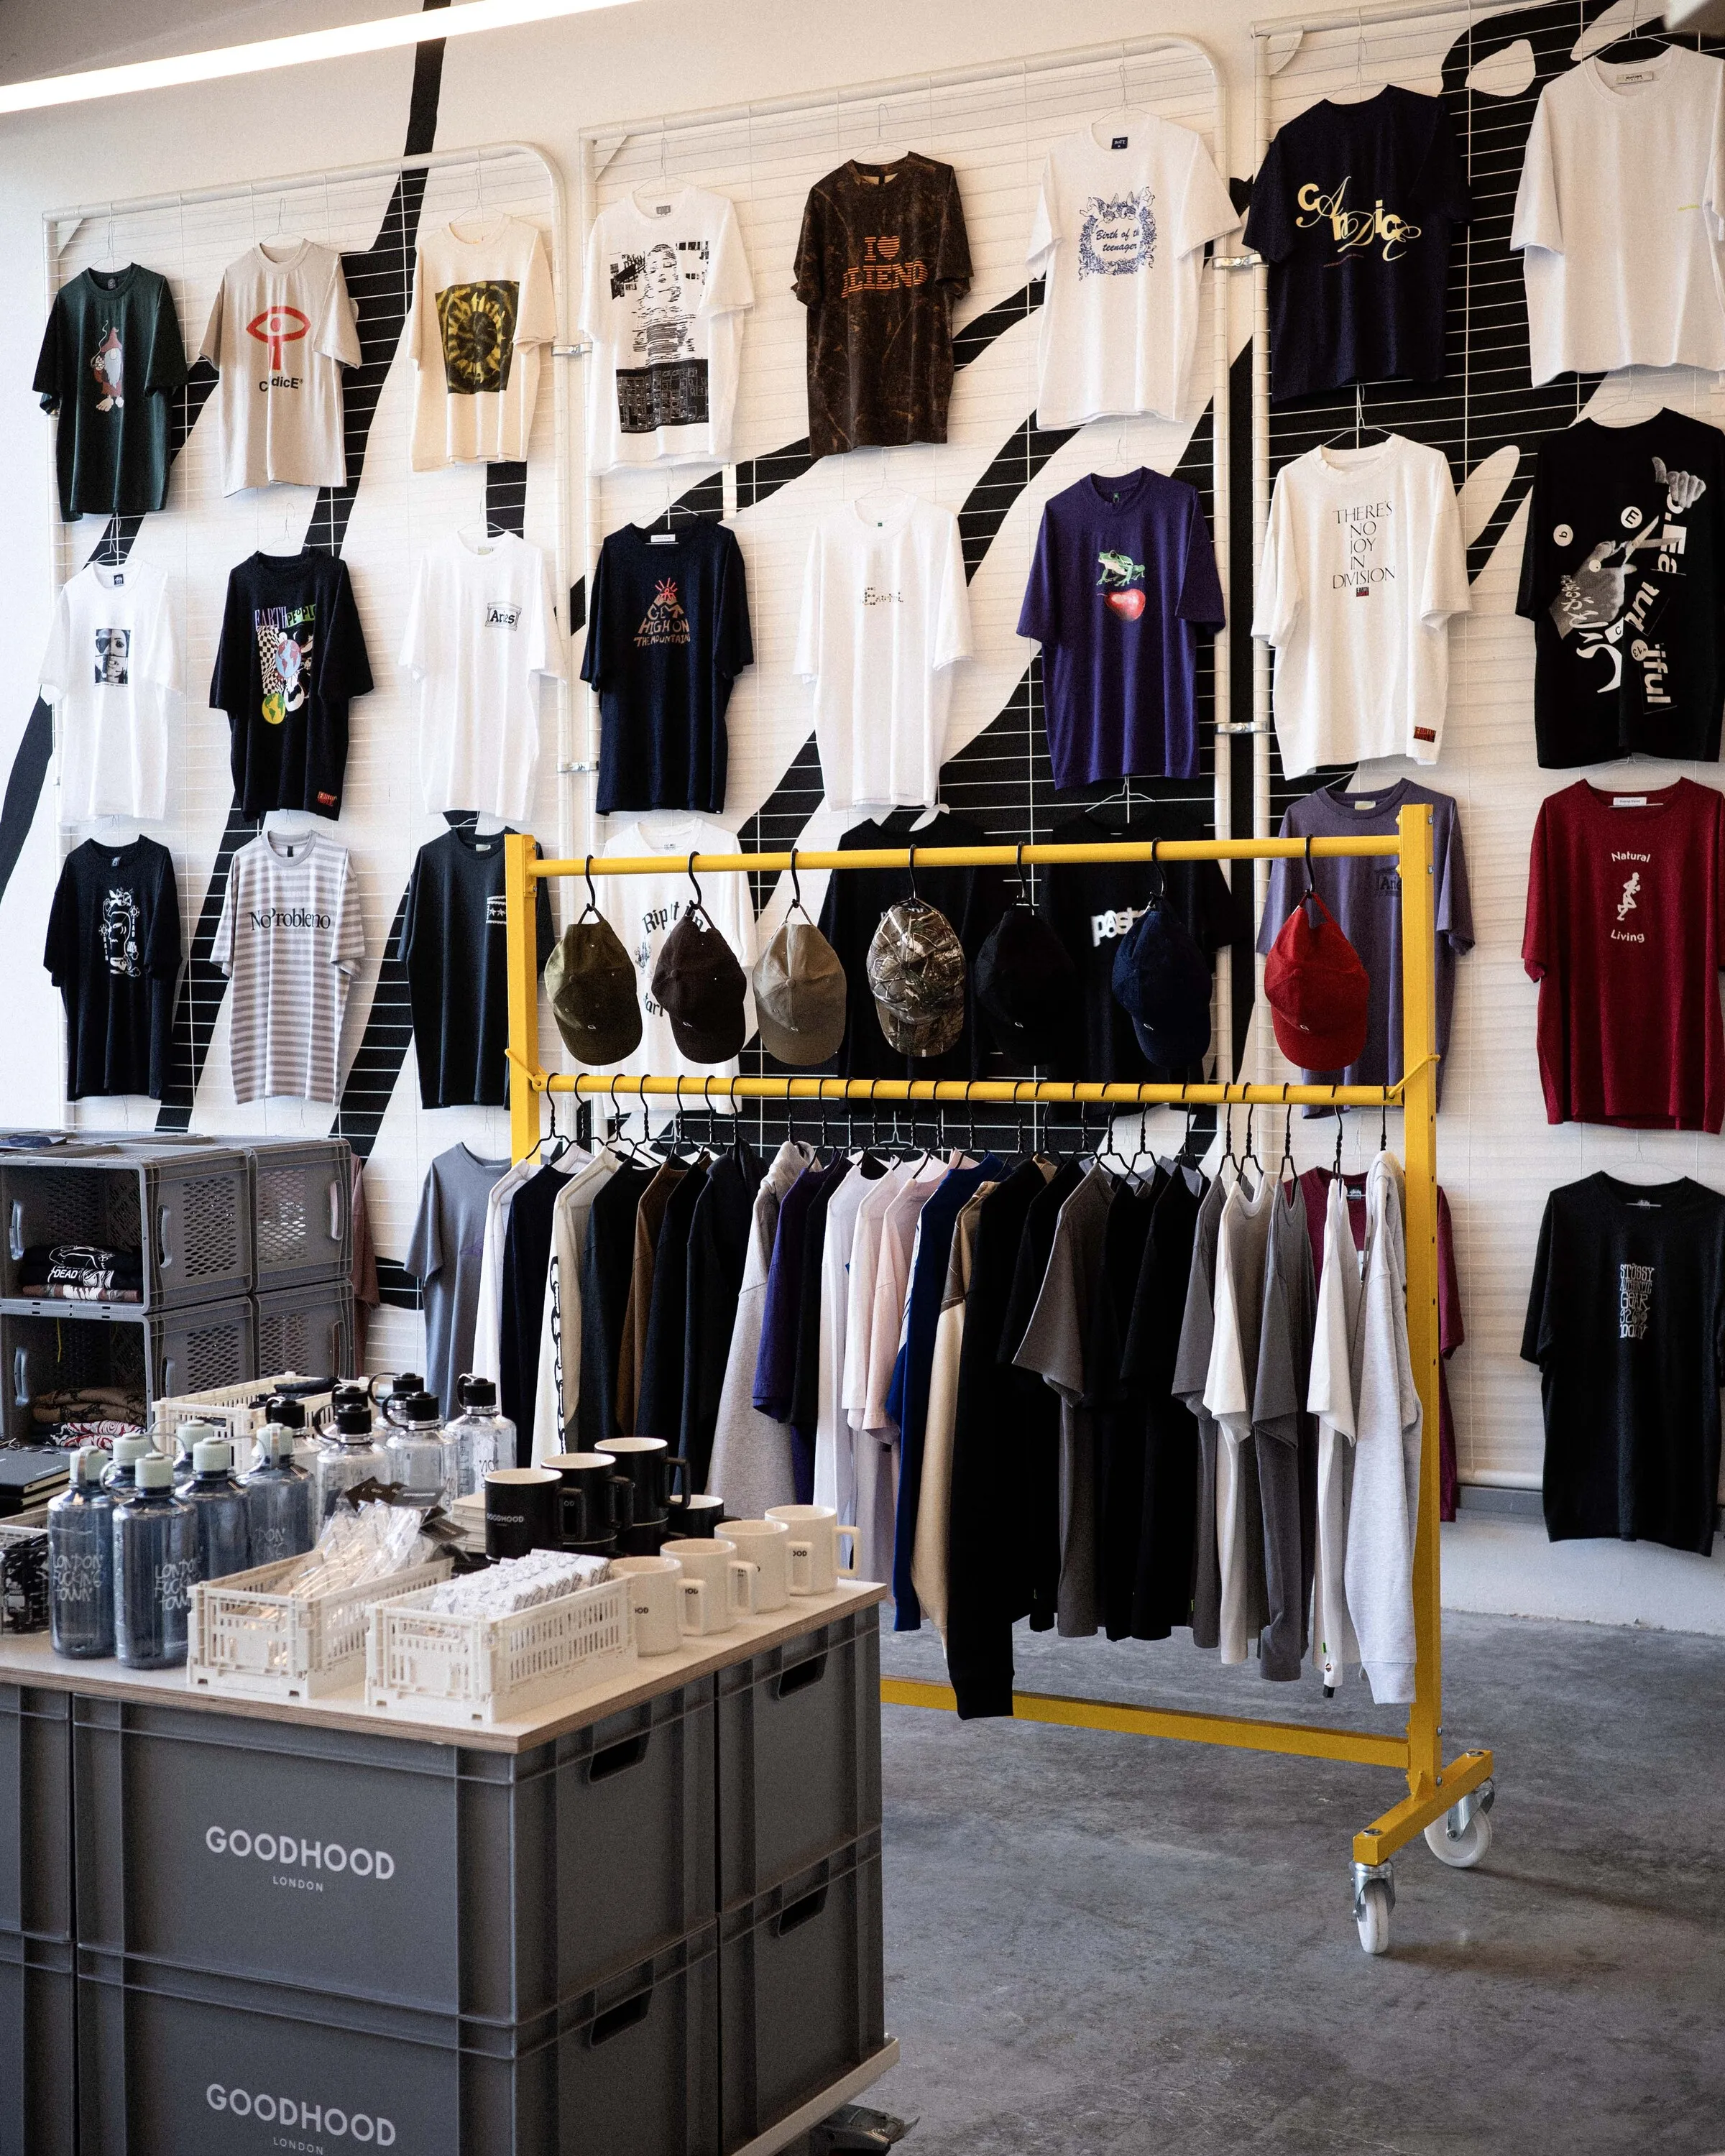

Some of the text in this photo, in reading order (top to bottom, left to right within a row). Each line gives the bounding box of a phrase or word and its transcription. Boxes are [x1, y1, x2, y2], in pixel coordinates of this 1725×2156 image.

[1096, 229, 1118, 241] Birth
[1121, 228, 1130, 241] of
[865, 236, 876, 261] I
[1103, 244, 1136, 253] teenager
[1333, 500, 1392, 524] THERE'S
[1350, 520, 1376, 538] NO
[1350, 537, 1377, 555] JOY
[1350, 555, 1365, 571] IN
[1333, 565, 1395, 589] DIVISION
[254, 606, 288, 632] EARTH
[647, 604, 684, 620] GET
[638, 618, 690, 635] HIGH ON
[633, 635, 650, 647] THE
[1611, 851, 1651, 862] Natural
[642, 908, 669, 934] Rip
[1611, 929, 1645, 943] Living
[53, 1268, 78, 1279] DEAD
[206, 1826, 395, 1880] GOODHOOD
[272, 1875, 323, 1893] LONDON
[206, 2083, 396, 2147] GOODHOOD
[273, 2137, 323, 2155] LONDON
